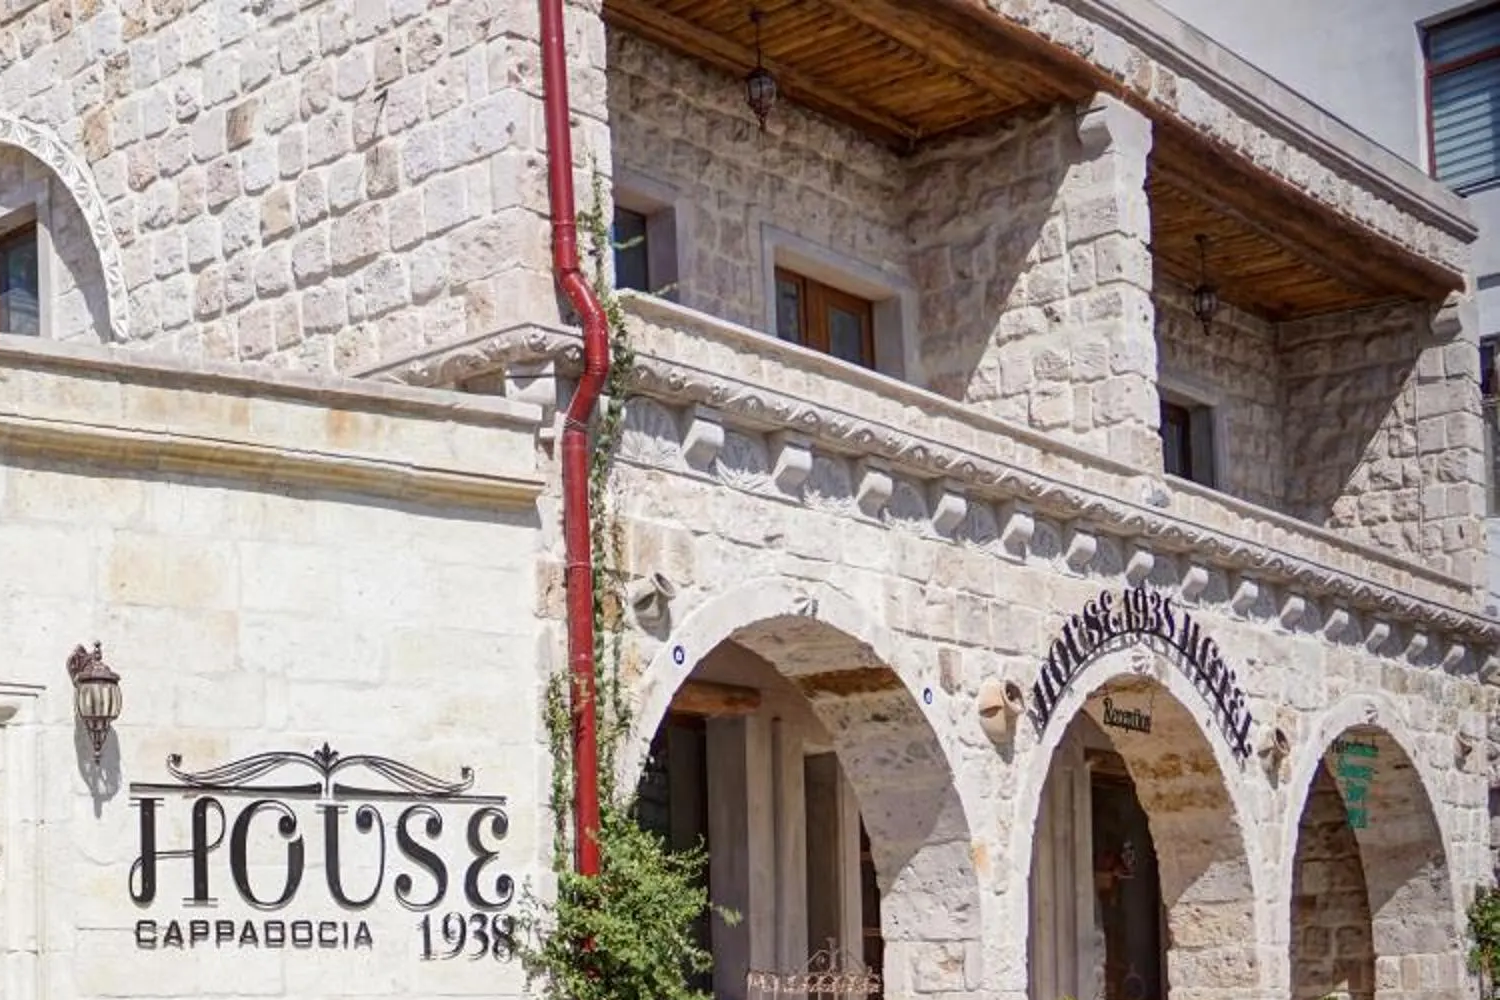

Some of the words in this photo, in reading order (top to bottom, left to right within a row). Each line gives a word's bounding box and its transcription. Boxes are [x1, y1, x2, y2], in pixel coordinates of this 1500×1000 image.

[1031, 589, 1121, 728] HOUSE
[1103, 697, 1151, 734] Reception
[128, 796, 514, 910] HOUSE
[135, 919, 373, 949] CAPPADOCIA
[417, 912, 515, 961] 1938
